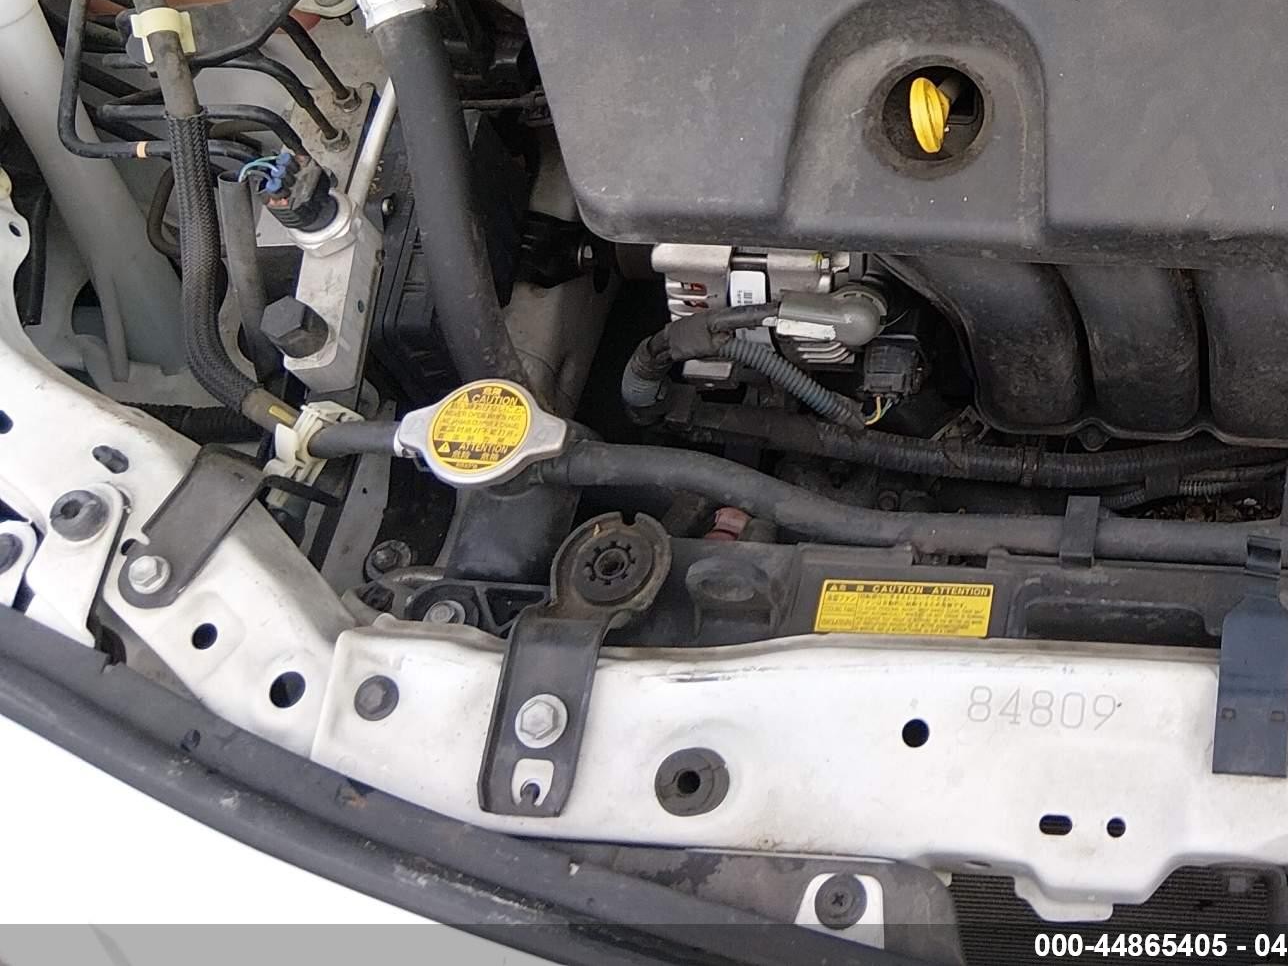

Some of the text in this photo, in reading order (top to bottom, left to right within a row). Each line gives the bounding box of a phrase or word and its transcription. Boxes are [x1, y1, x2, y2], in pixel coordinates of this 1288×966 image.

[472, 394, 518, 405] CAUTION
[458, 442, 508, 454] ATTENTION
[872, 585, 924, 594] CAUTION
[931, 586, 988, 596] ATTENTION
[967, 685, 1116, 731] 84809
